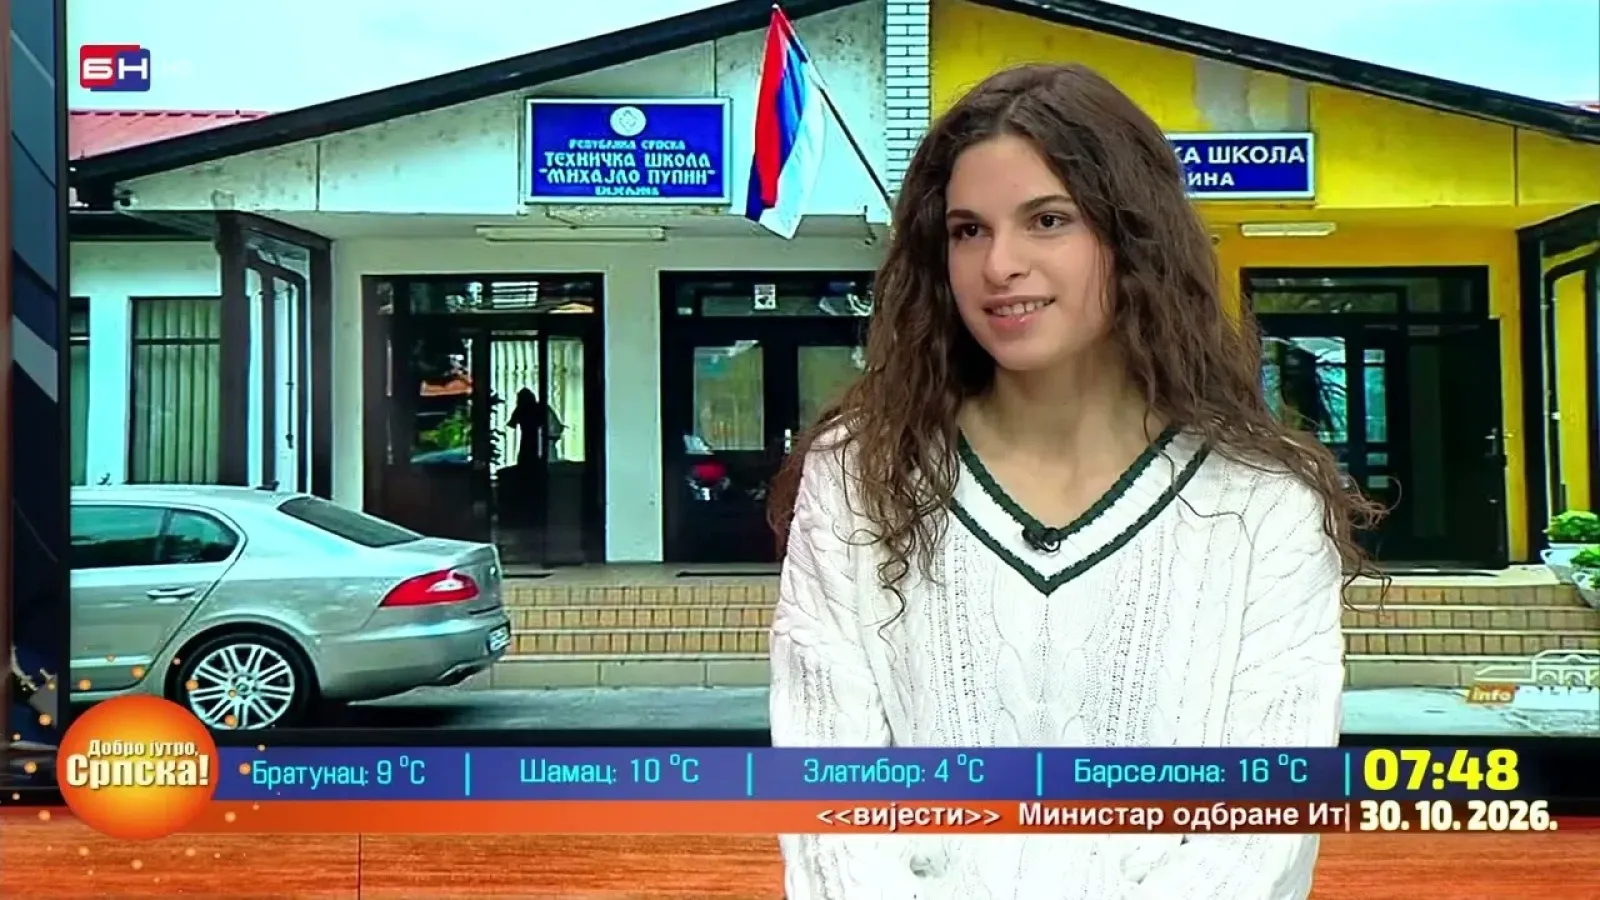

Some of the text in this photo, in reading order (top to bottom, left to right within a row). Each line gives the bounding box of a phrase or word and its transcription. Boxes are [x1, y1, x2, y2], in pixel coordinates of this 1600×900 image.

[544, 151, 711, 168] ТЕХНИЧКА ШКОЛА
[1207, 145, 1306, 164] ШКОЛА
